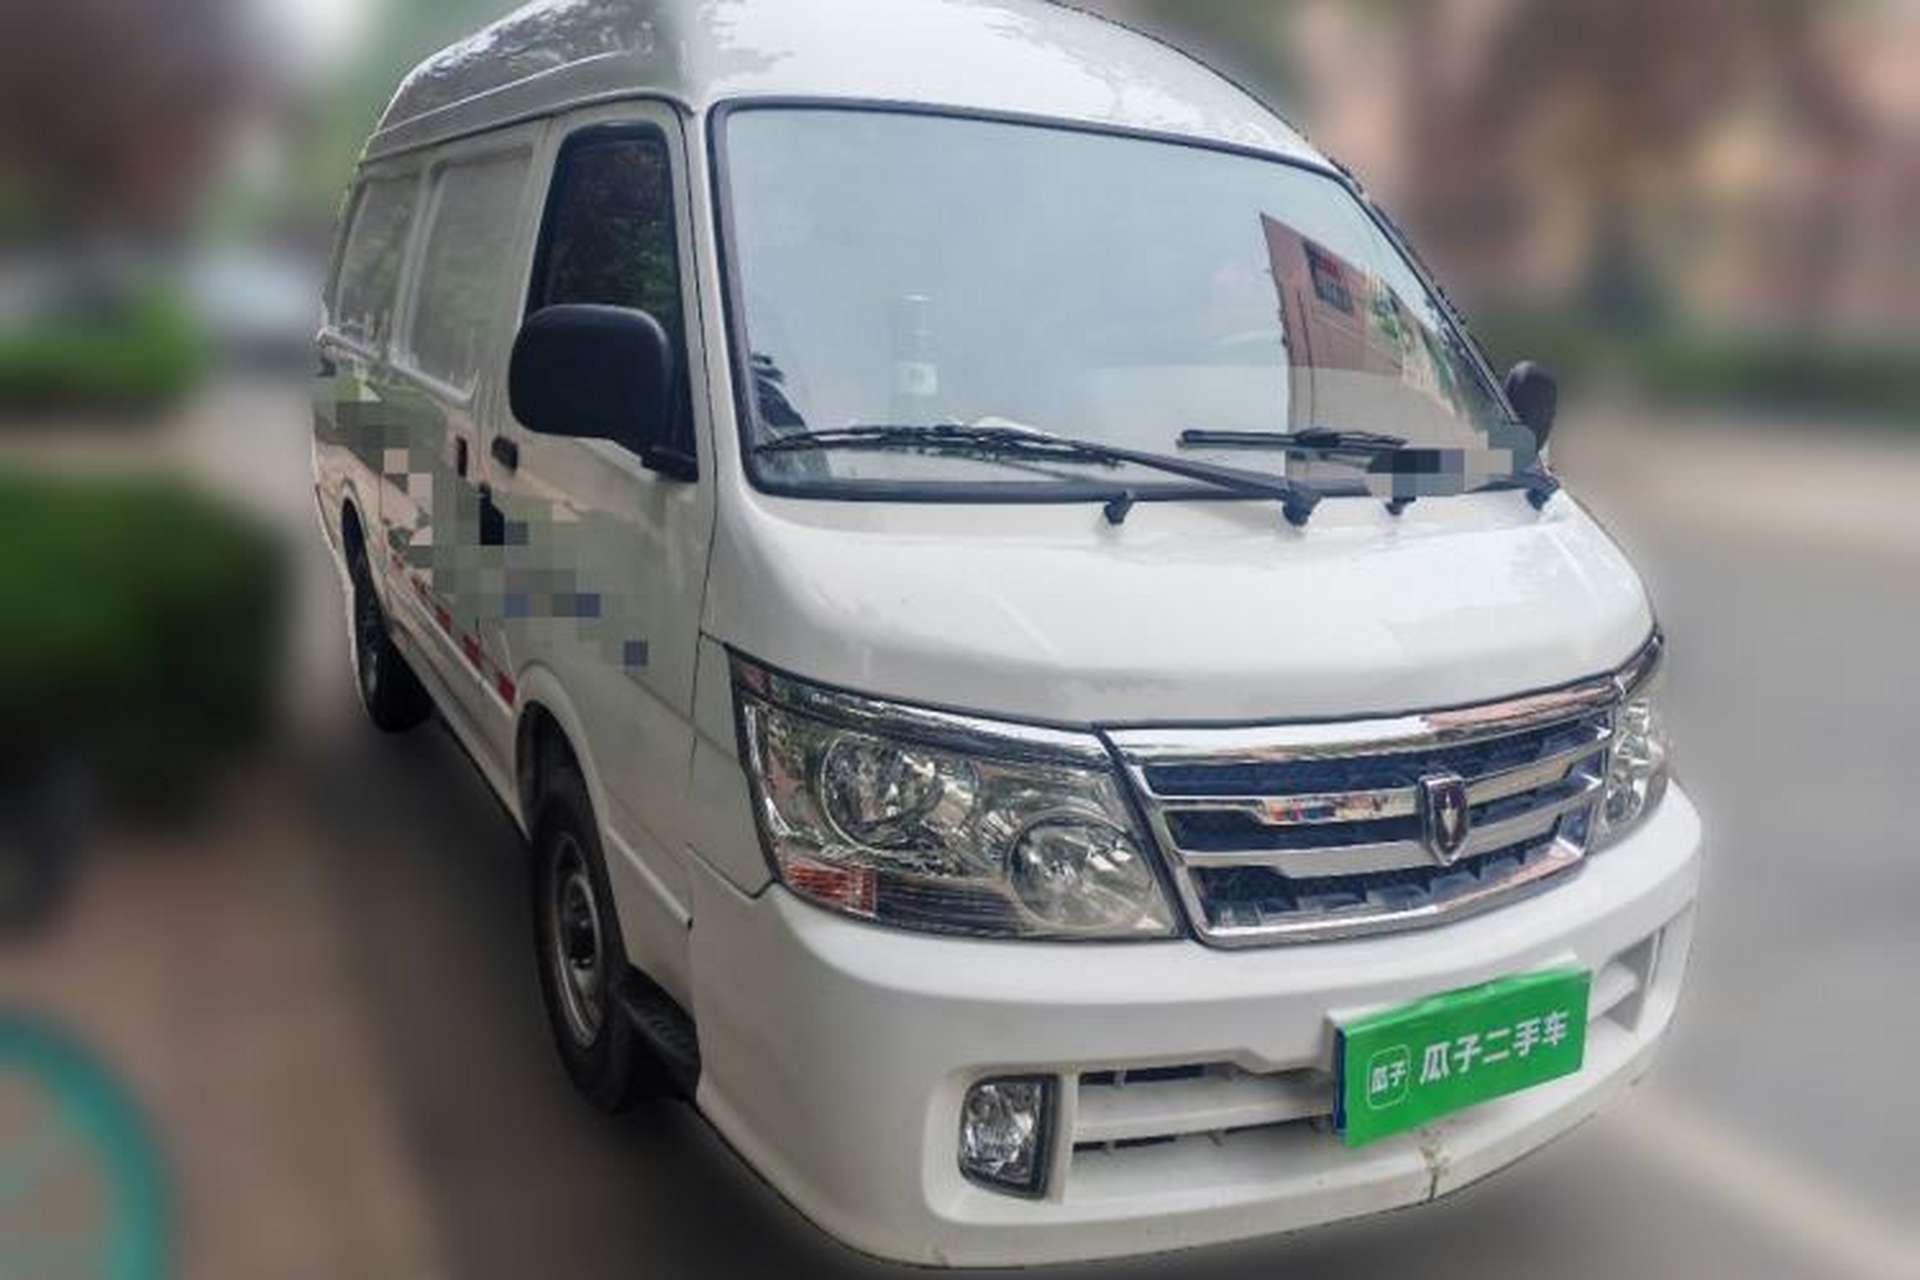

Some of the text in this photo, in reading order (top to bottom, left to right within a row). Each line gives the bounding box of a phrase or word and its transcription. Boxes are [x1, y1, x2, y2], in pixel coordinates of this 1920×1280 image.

[1419, 1010, 1569, 1085] 瓜子二手车
[1370, 1060, 1407, 1093] 瓜子
